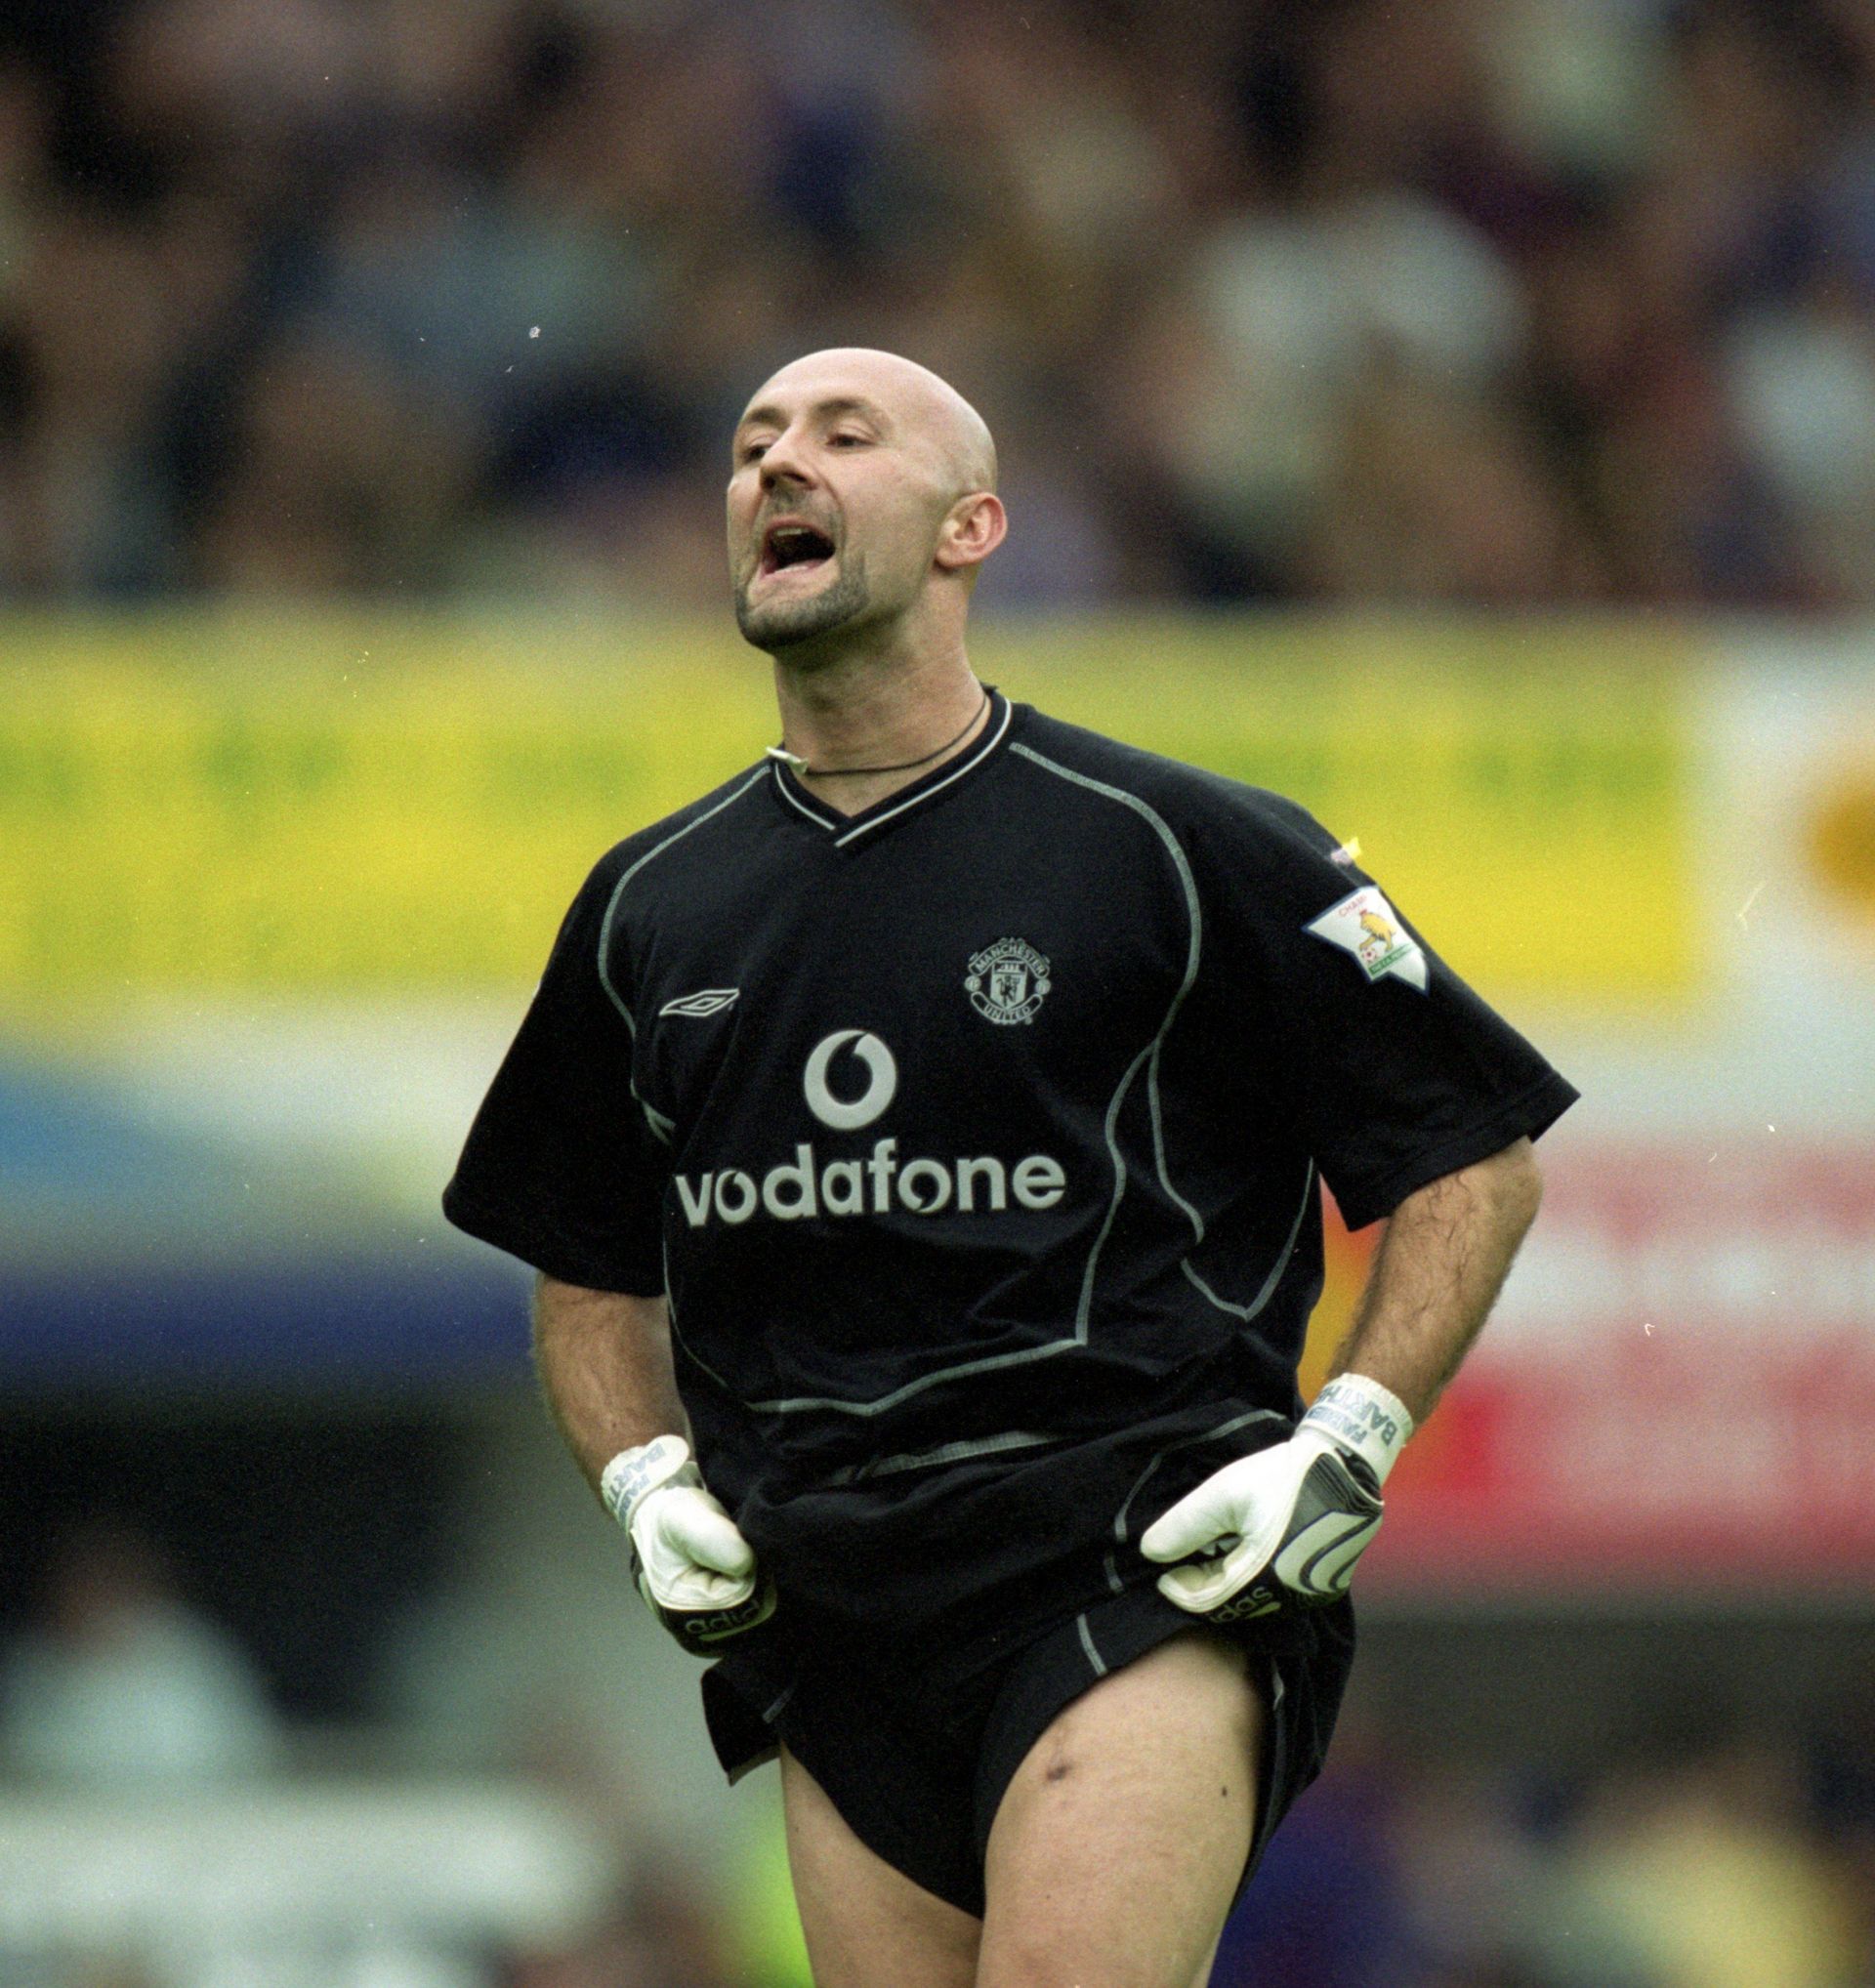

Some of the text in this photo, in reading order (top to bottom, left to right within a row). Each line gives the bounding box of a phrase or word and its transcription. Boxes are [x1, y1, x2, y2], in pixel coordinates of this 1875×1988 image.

[975, 943, 1046, 974] MANCHESTER
[983, 1003, 1030, 1020] UNITED
[675, 1137, 1066, 1227] vodafone
